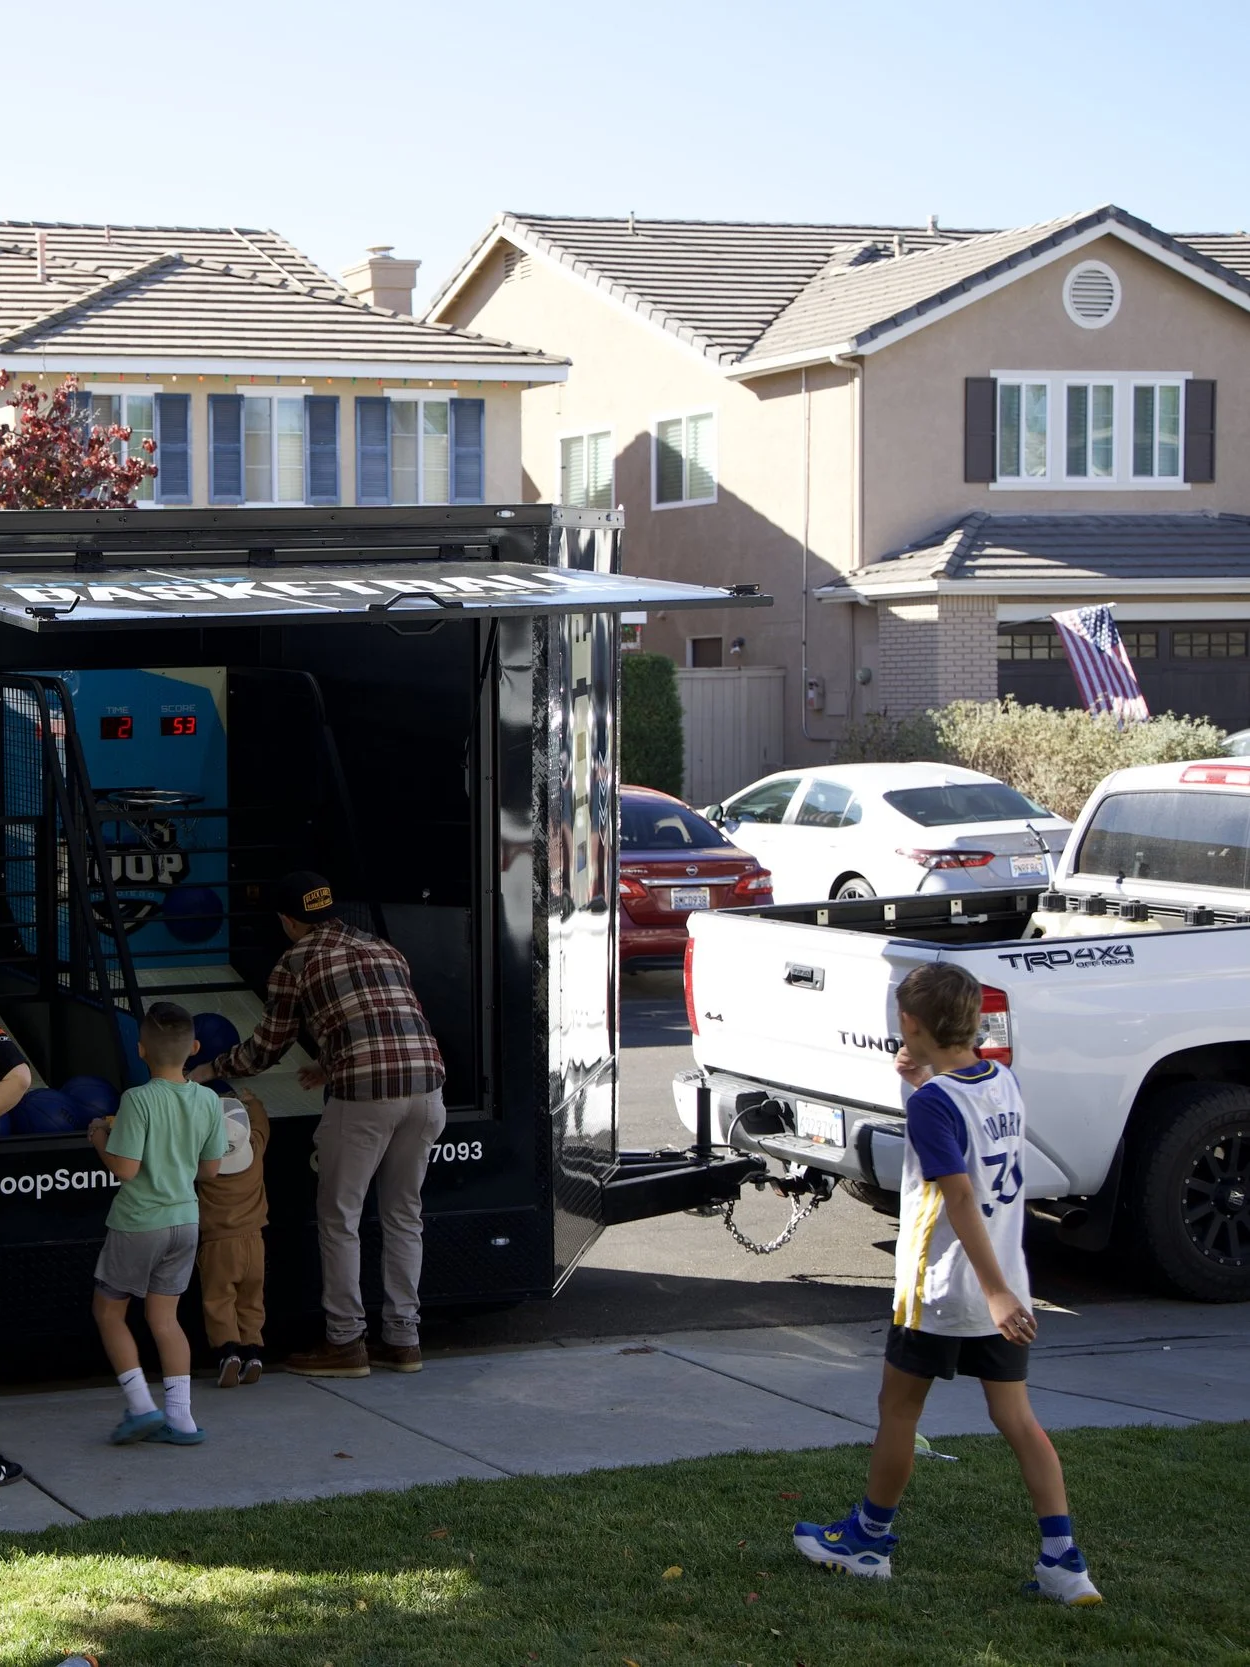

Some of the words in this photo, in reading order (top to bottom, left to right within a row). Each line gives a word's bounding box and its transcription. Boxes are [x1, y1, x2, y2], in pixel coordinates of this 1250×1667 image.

[11, 573, 620, 603] BASKETBALL
[105, 705, 131, 715] TIME
[160, 703, 197, 714] SCORE
[118, 717, 132, 738] 2
[173, 717, 196, 735] 53
[998, 949, 1075, 973] TRD
[1076, 960, 1101, 969] OFF
[1101, 958, 1135, 967] ROAD
[838, 1030, 900, 1054] TUND
